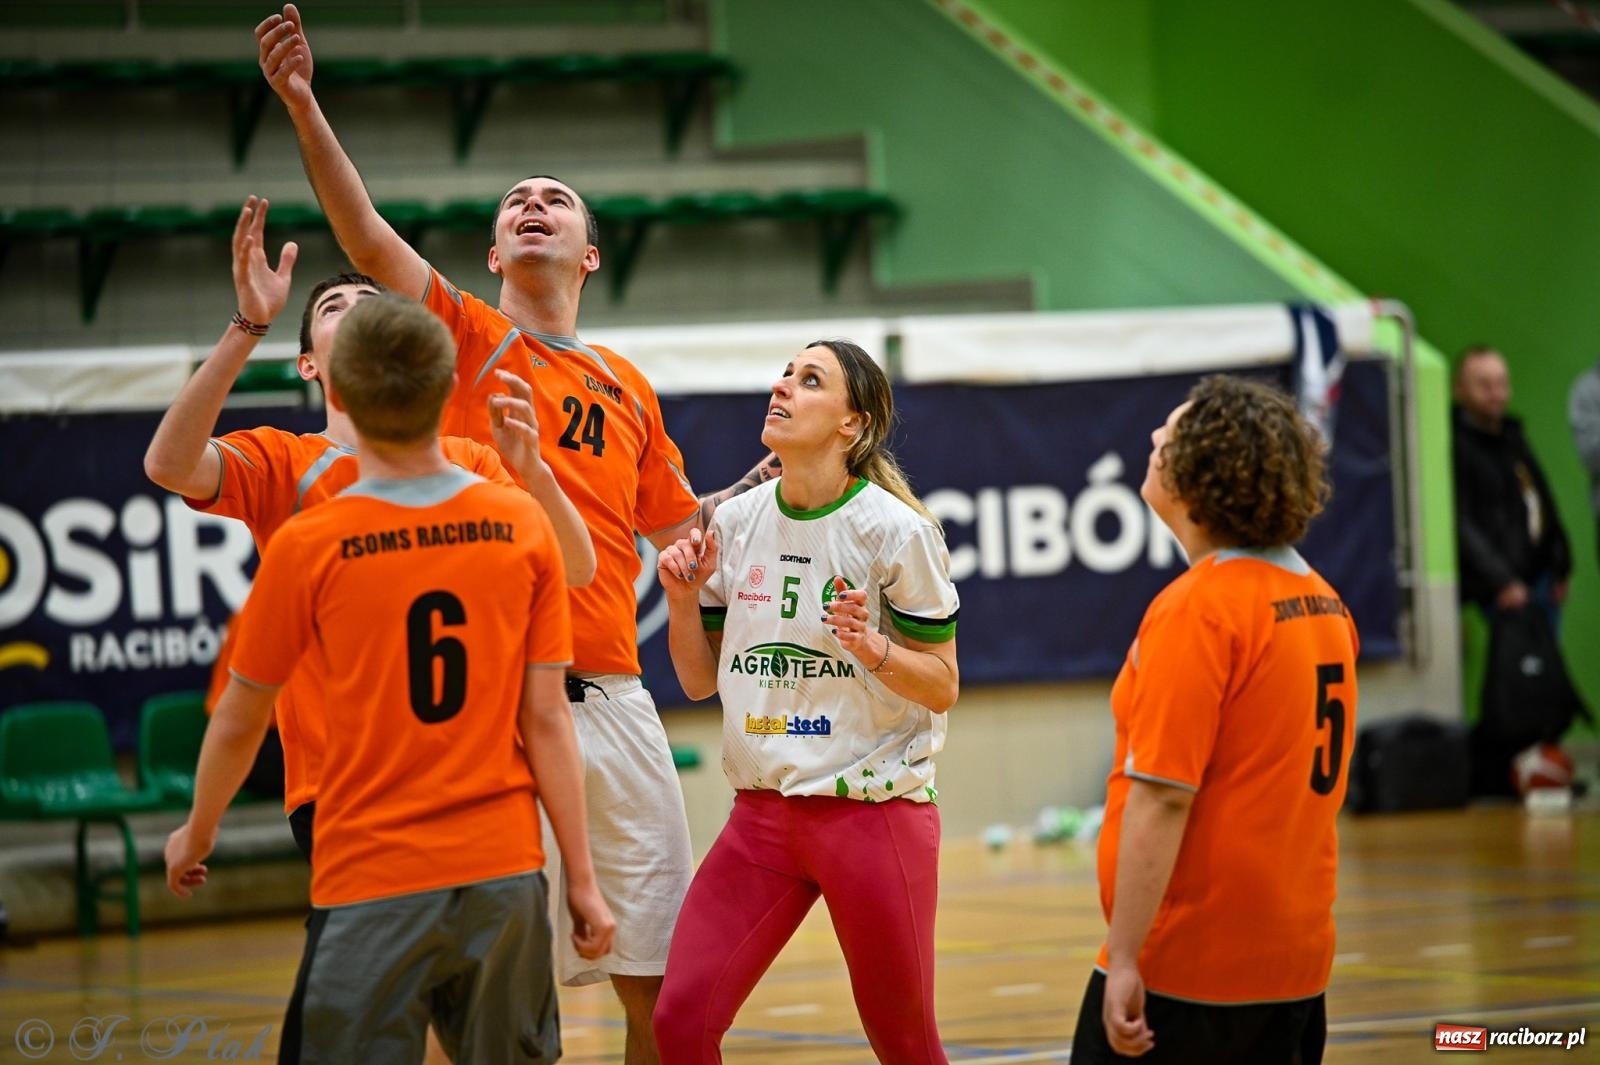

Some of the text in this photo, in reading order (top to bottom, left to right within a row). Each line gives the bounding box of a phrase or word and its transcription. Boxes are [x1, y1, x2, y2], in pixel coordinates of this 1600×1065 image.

[583, 374, 622, 404] ZSOMS
[558, 395, 605, 457] 24
[341, 517, 514, 560] ZSOMS RACIBÓRZ
[922, 450, 1189, 583] CIBÓ
[780, 575, 801, 620] 5
[406, 589, 468, 725] 6
[759, 679, 797, 690] KIETRZ
[745, 712, 832, 735] instal-tech
[1310, 663, 1346, 796] 5
